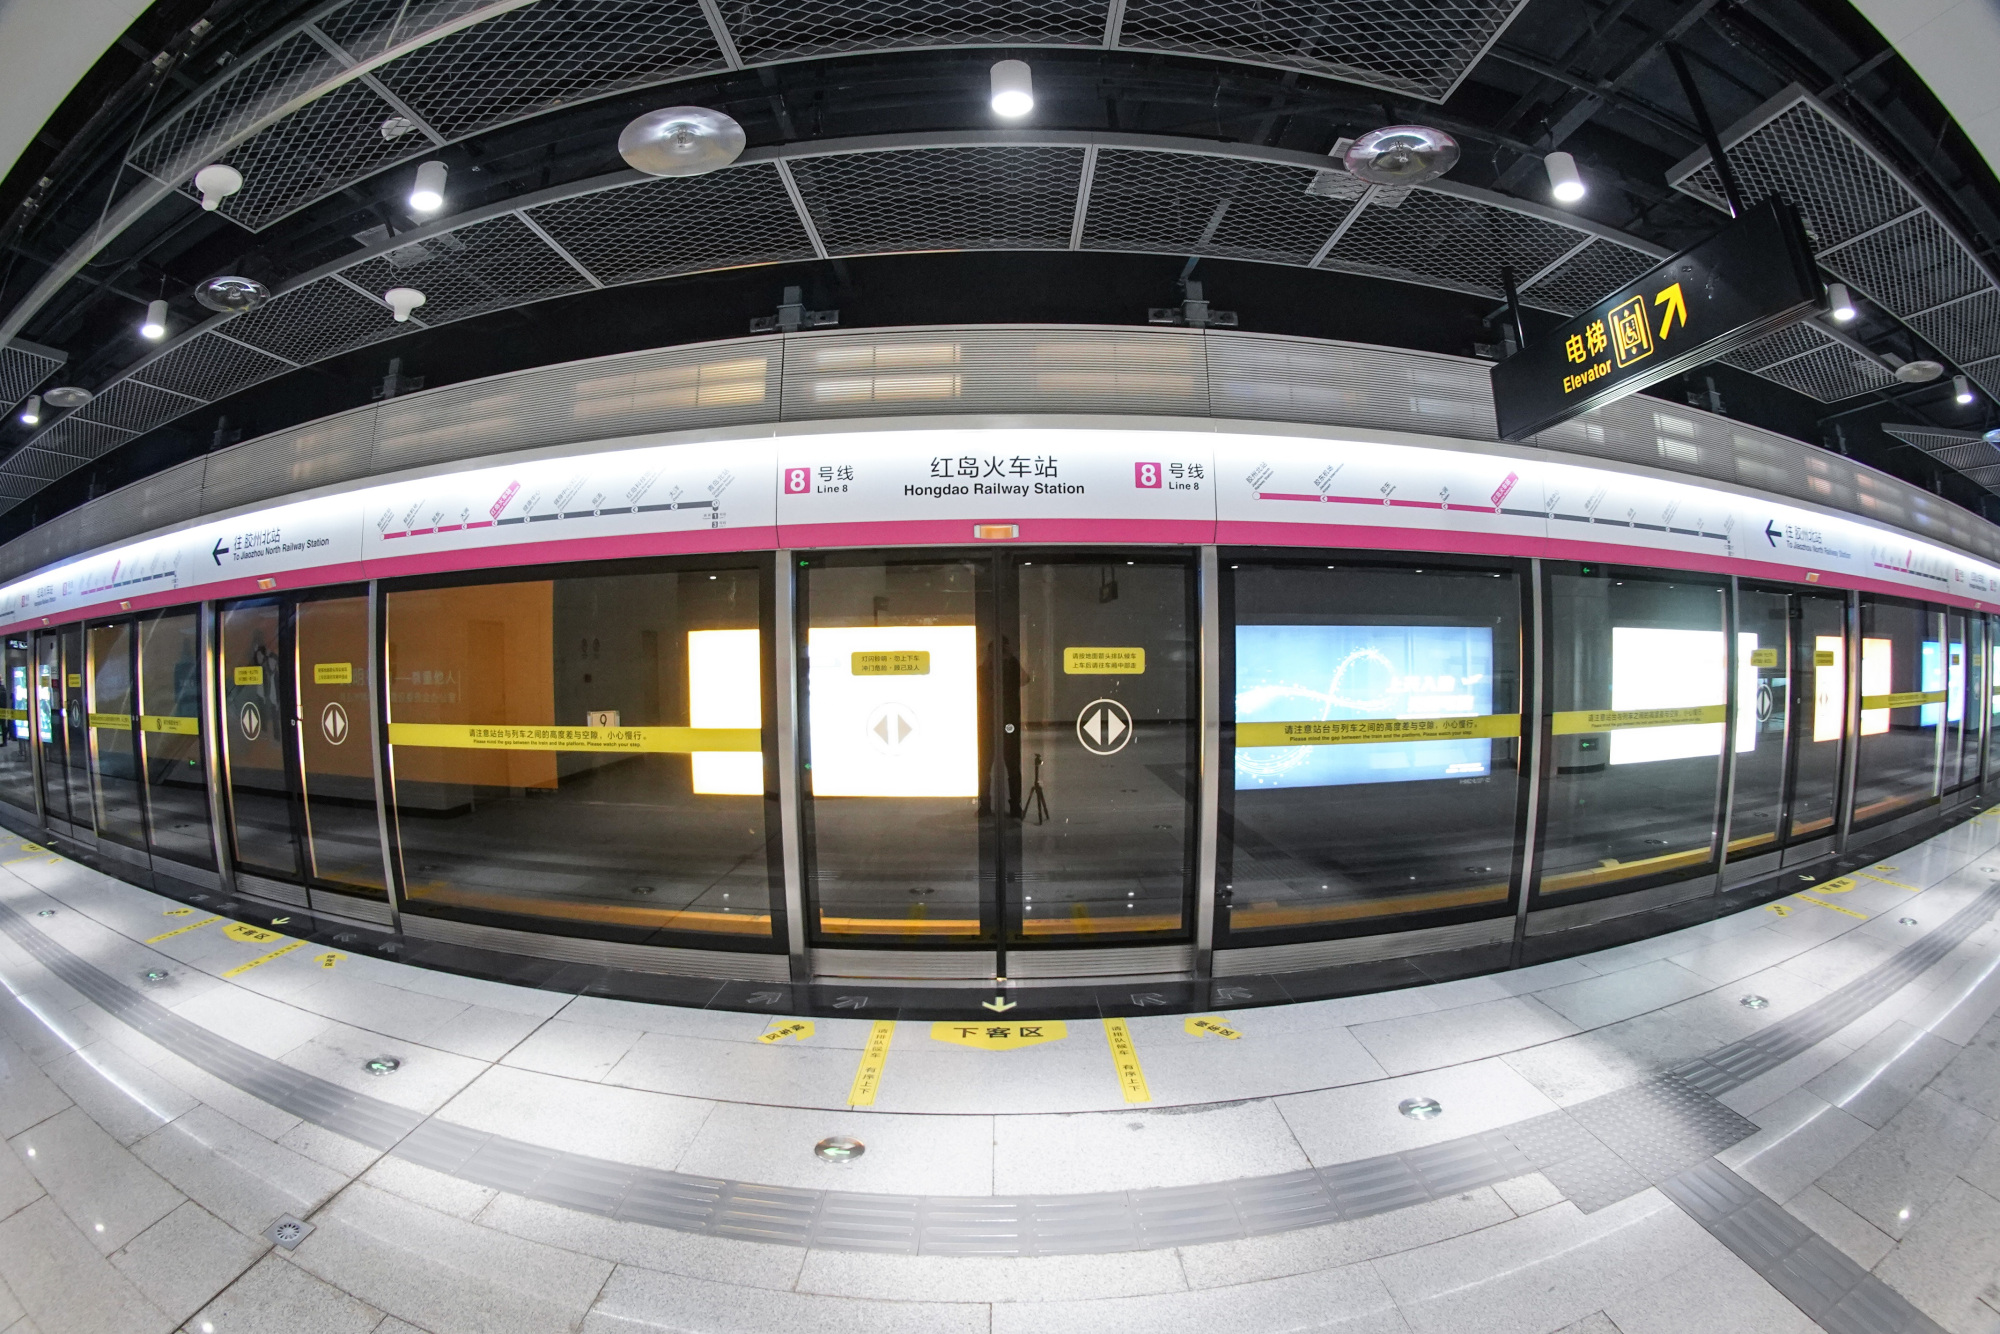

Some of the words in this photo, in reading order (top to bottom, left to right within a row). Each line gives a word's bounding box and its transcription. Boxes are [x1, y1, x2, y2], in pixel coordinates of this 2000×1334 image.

[1566, 319, 1608, 363] 电梯
[1563, 359, 1611, 393] Elevator
[790, 470, 805, 492] 8
[818, 465, 854, 481] 号线
[931, 456, 1057, 478] 红岛火车站
[1141, 464, 1156, 486] 8
[1169, 463, 1204, 479] 号线
[818, 485, 840, 493] Line
[905, 484, 969, 498] Hongdao
[974, 483, 1029, 497] Railway
[1034, 483, 1084, 495] Station
[1169, 482, 1190, 490] Line
[1194, 482, 1199, 490] 8
[233, 553, 240, 561] To
[241, 550, 264, 560] Jiaozhou
[266, 546, 280, 555] North
[282, 542, 305, 552] Railway
[307, 538, 329, 548] Station
[234, 535, 242, 550] 往
[244, 527, 280, 548] 胶州北站
[953, 1027, 1044, 1038] 下客区
[860, 1067, 876, 1094] 有序上下
[1123, 1064, 1140, 1091] 有序上下
